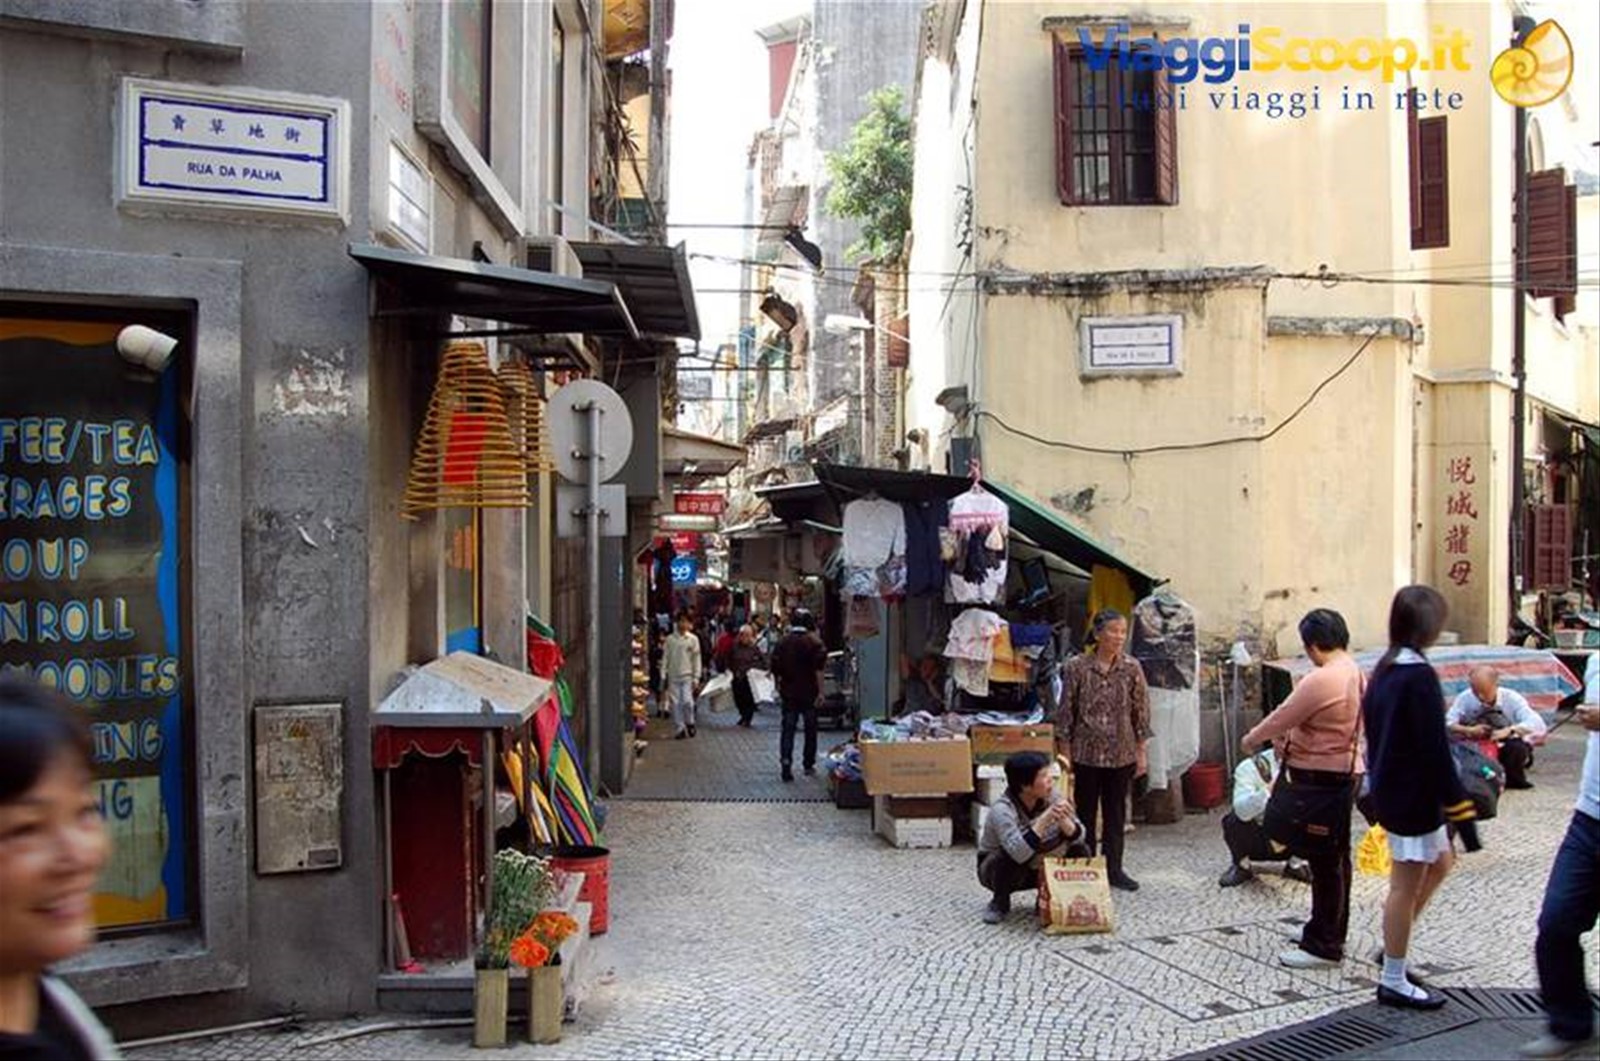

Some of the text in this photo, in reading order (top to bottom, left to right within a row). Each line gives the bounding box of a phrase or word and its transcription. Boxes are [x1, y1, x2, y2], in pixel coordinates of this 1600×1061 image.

[187, 161, 282, 182] RUA DA PALHA
[37, 597, 135, 643] ROLL
